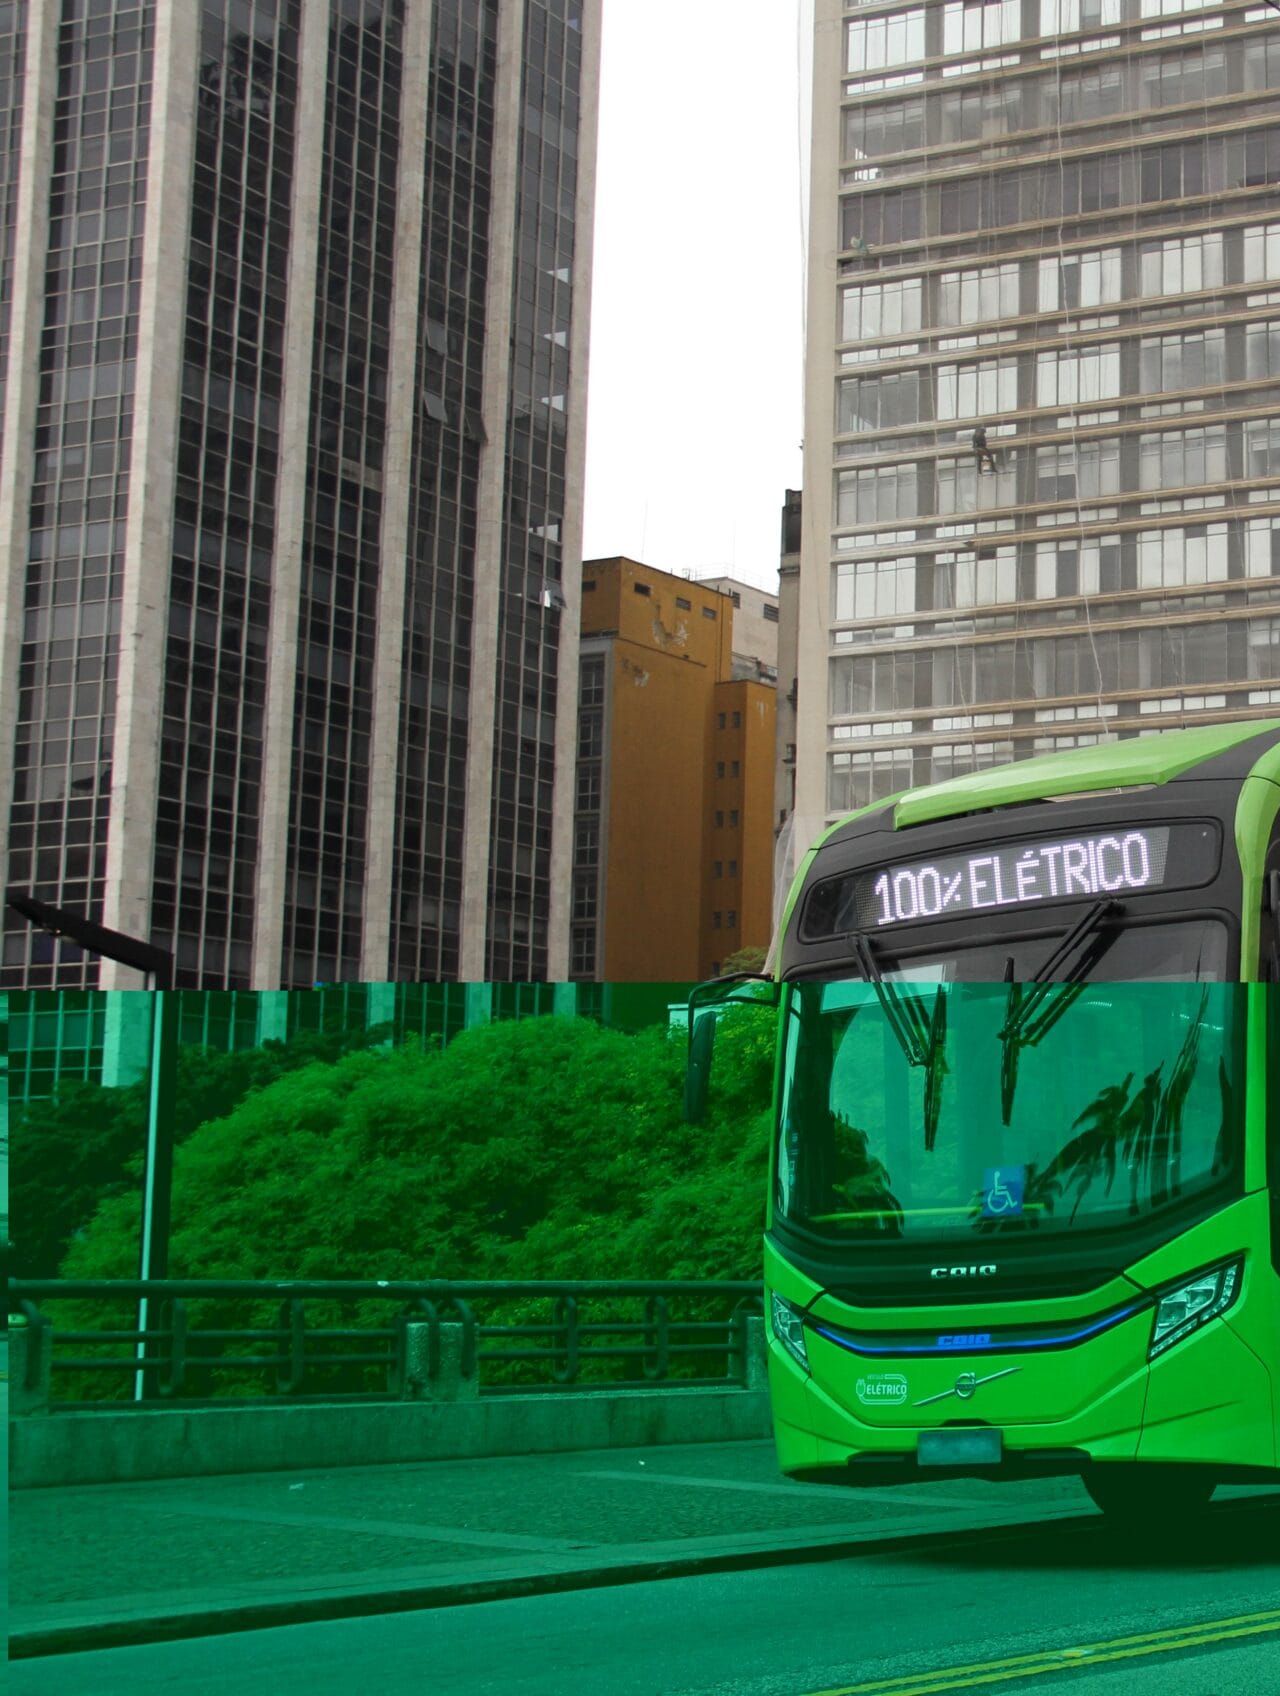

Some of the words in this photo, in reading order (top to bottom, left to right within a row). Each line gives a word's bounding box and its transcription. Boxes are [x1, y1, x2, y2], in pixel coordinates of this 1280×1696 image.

[874, 866, 963, 925] 100%
[969, 832, 1151, 908] ELÉTRICO
[866, 1381, 908, 1396] ELÉTRICO
